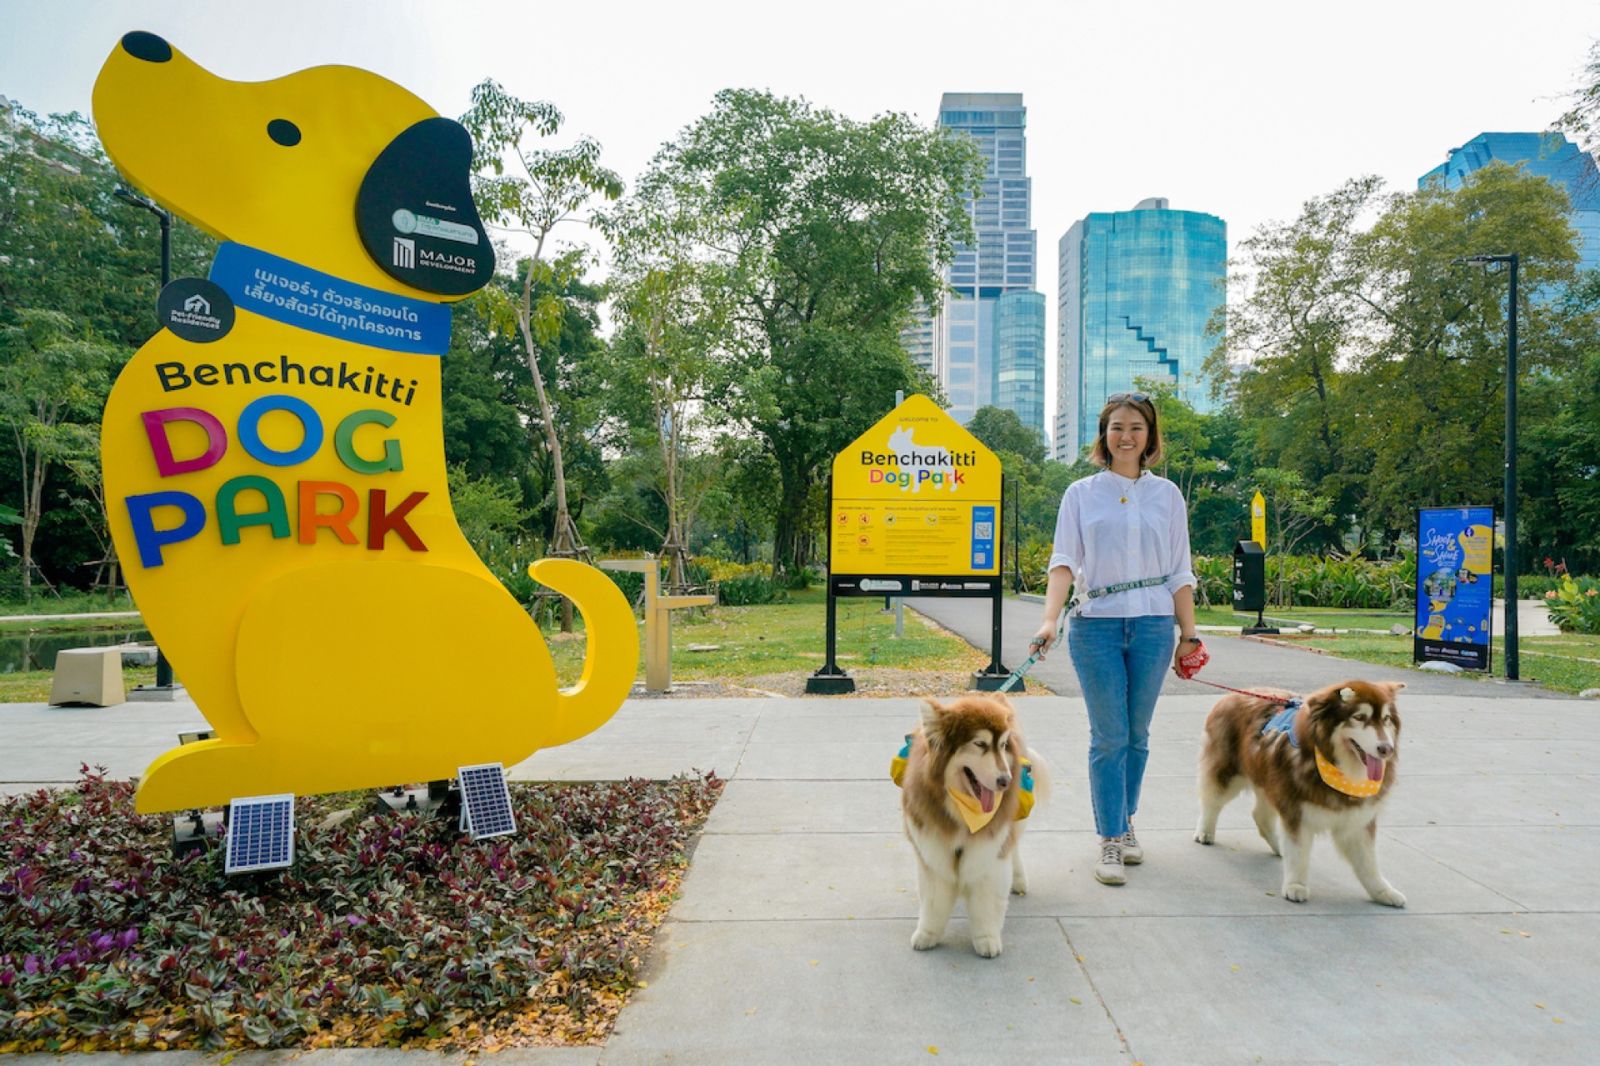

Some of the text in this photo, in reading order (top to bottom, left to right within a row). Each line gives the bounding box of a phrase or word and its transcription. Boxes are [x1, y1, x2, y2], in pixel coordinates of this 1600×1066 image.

[420, 249, 476, 268] MAJOR
[420, 260, 475, 274] DEVELOPMENT
[244, 281, 423, 341] เลี้ยงสัตว์ได้ทุกโครงการ
[322, 287, 419, 323] ตัวจริงคอนโด
[171, 315, 220, 329] Residences
[154, 355, 419, 406] Benchakitti
[140, 394, 404, 478] DOG
[861, 450, 975, 467] Benchakitti
[870, 469, 965, 487] Dog Park
[125, 475, 430, 569] PARK
